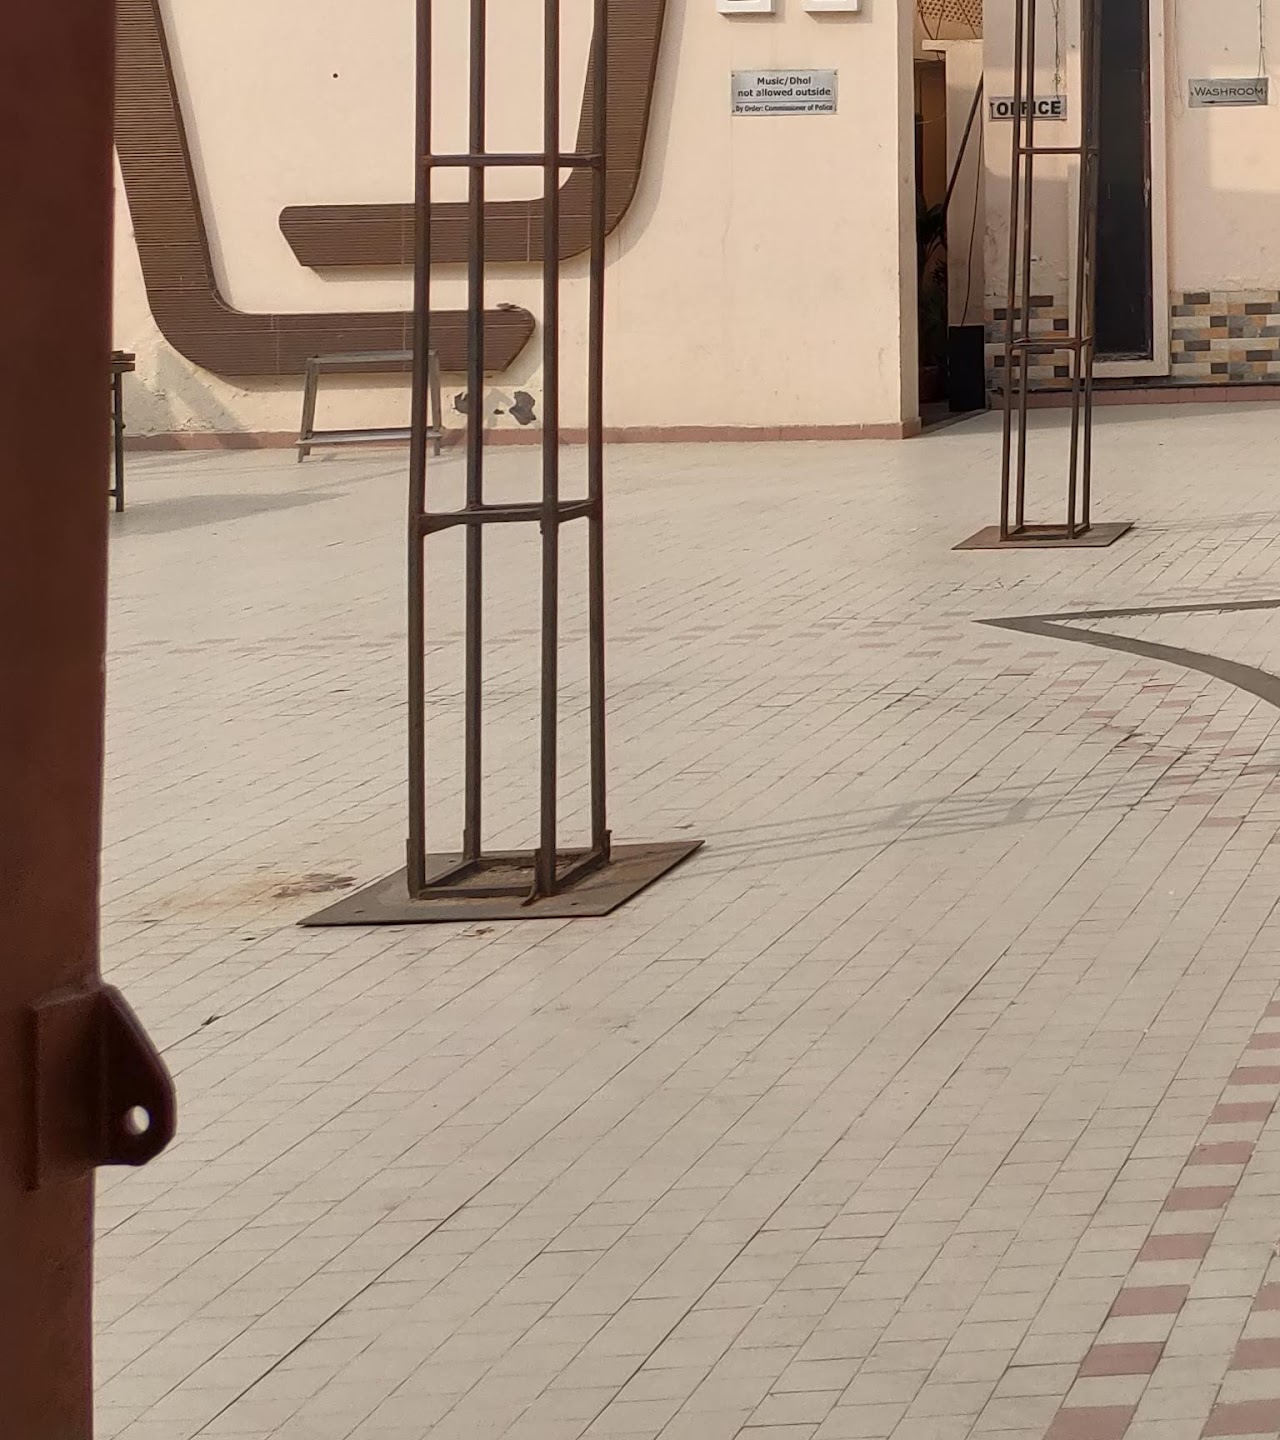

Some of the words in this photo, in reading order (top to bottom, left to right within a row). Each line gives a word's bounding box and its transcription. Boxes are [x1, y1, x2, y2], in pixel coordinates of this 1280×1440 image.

[757, 77, 812, 86] Music/Dhol
[738, 89, 753, 97] not
[756, 88, 793, 97] allowed
[795, 87, 831, 96] outside
[1194, 86, 1264, 97] WASHROOM
[736, 105, 743, 113] By
